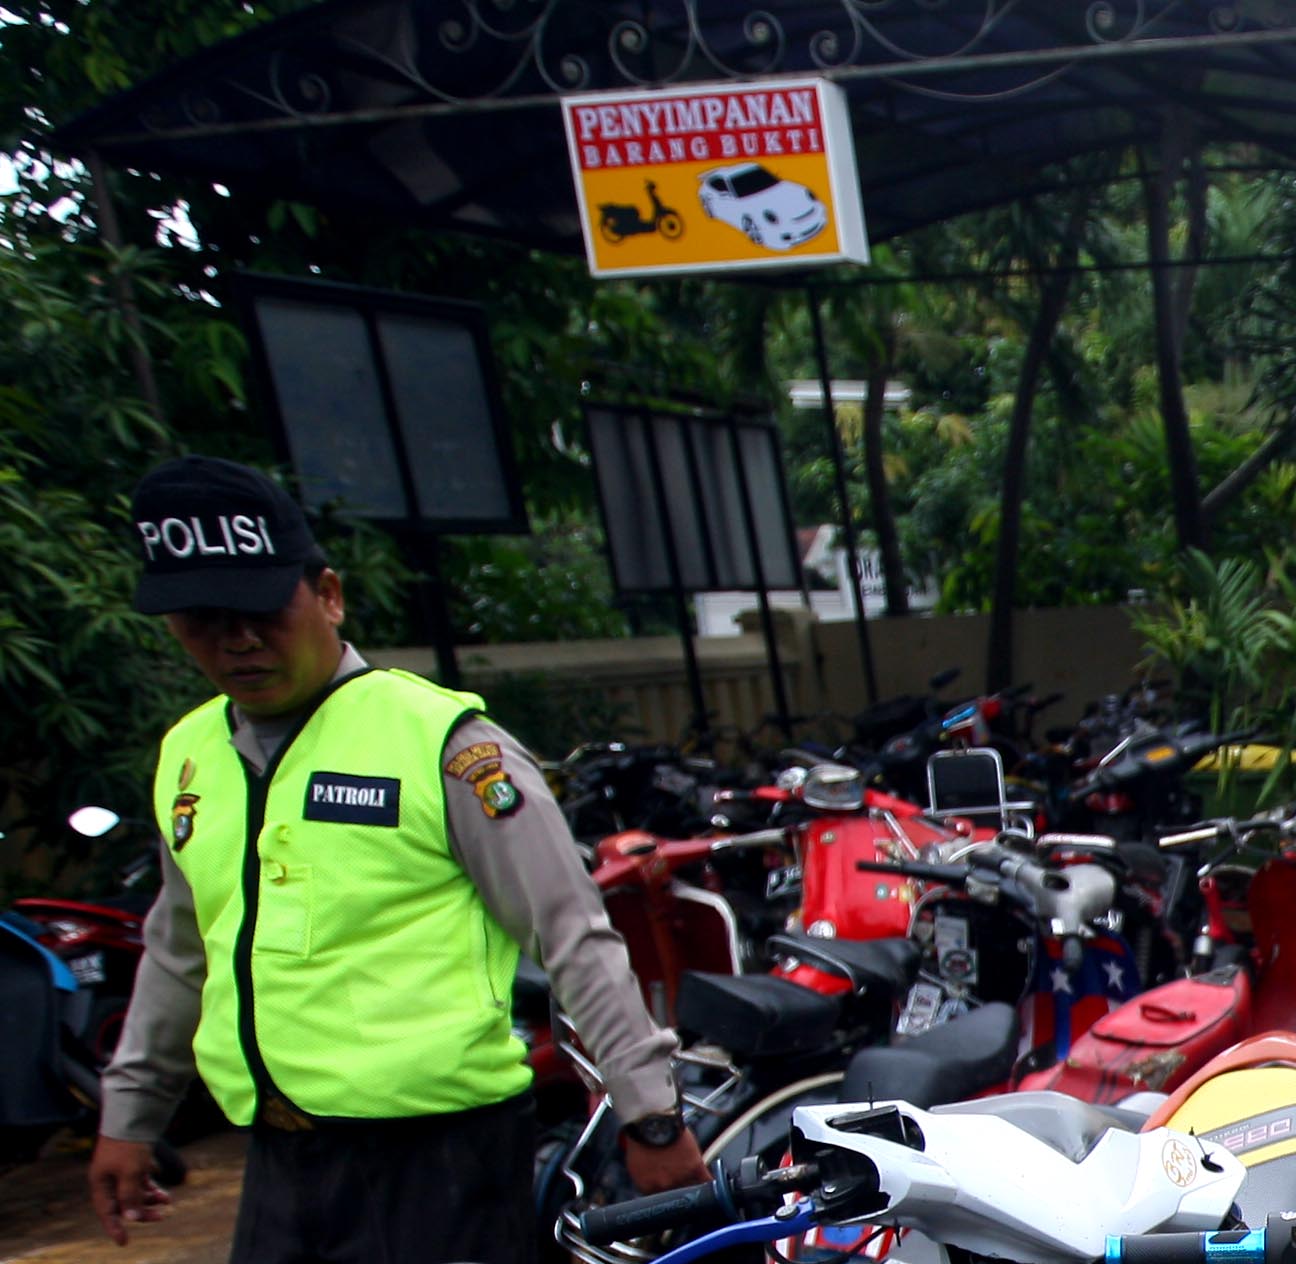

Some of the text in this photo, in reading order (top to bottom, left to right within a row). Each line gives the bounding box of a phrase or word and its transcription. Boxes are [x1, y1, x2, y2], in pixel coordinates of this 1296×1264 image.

[576, 90, 814, 140] PENYIMPANAN
[583, 129, 821, 168] BARANG BUKTI
[137, 515, 276, 561] POLISI
[313, 783, 386, 807] PATROLI
